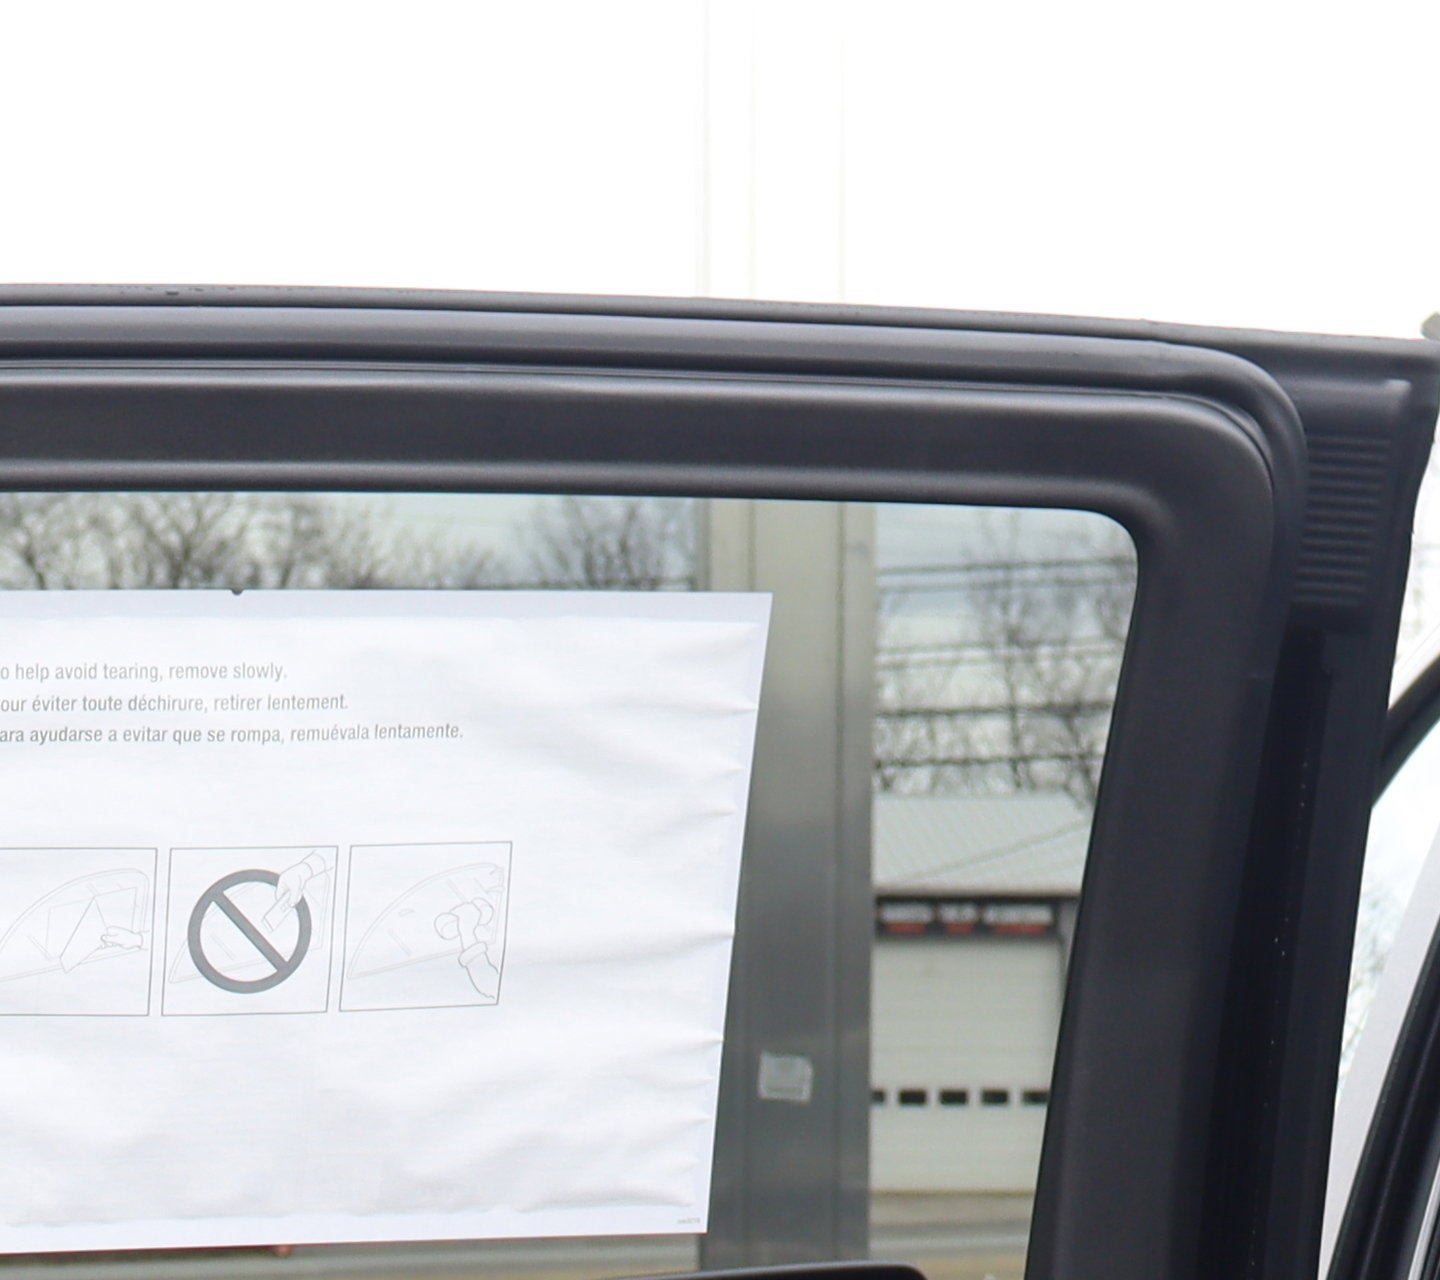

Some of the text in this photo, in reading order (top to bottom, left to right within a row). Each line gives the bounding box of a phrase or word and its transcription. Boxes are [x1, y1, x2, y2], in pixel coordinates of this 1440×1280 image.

[16, 664, 49, 683] help
[55, 663, 97, 679] avoid
[104, 664, 162, 682] tearing,
[170, 666, 227, 679] remove
[233, 663, 286, 682] slowly.
[32, 696, 77, 712] éviter
[82, 696, 122, 711] toute
[128, 695, 207, 713] déchirure,
[215, 695, 262, 710] retirer
[268, 694, 348, 710] lentement.
[30, 726, 102, 745] ayudarse
[108, 730, 117, 741] a
[123, 726, 168, 742] evitar
[173, 730, 202, 745] que
[207, 730, 225, 742] se
[231, 730, 284, 745] rompa,
[291, 724, 369, 741] remuévala
[375, 723, 463, 739] lentamente.
